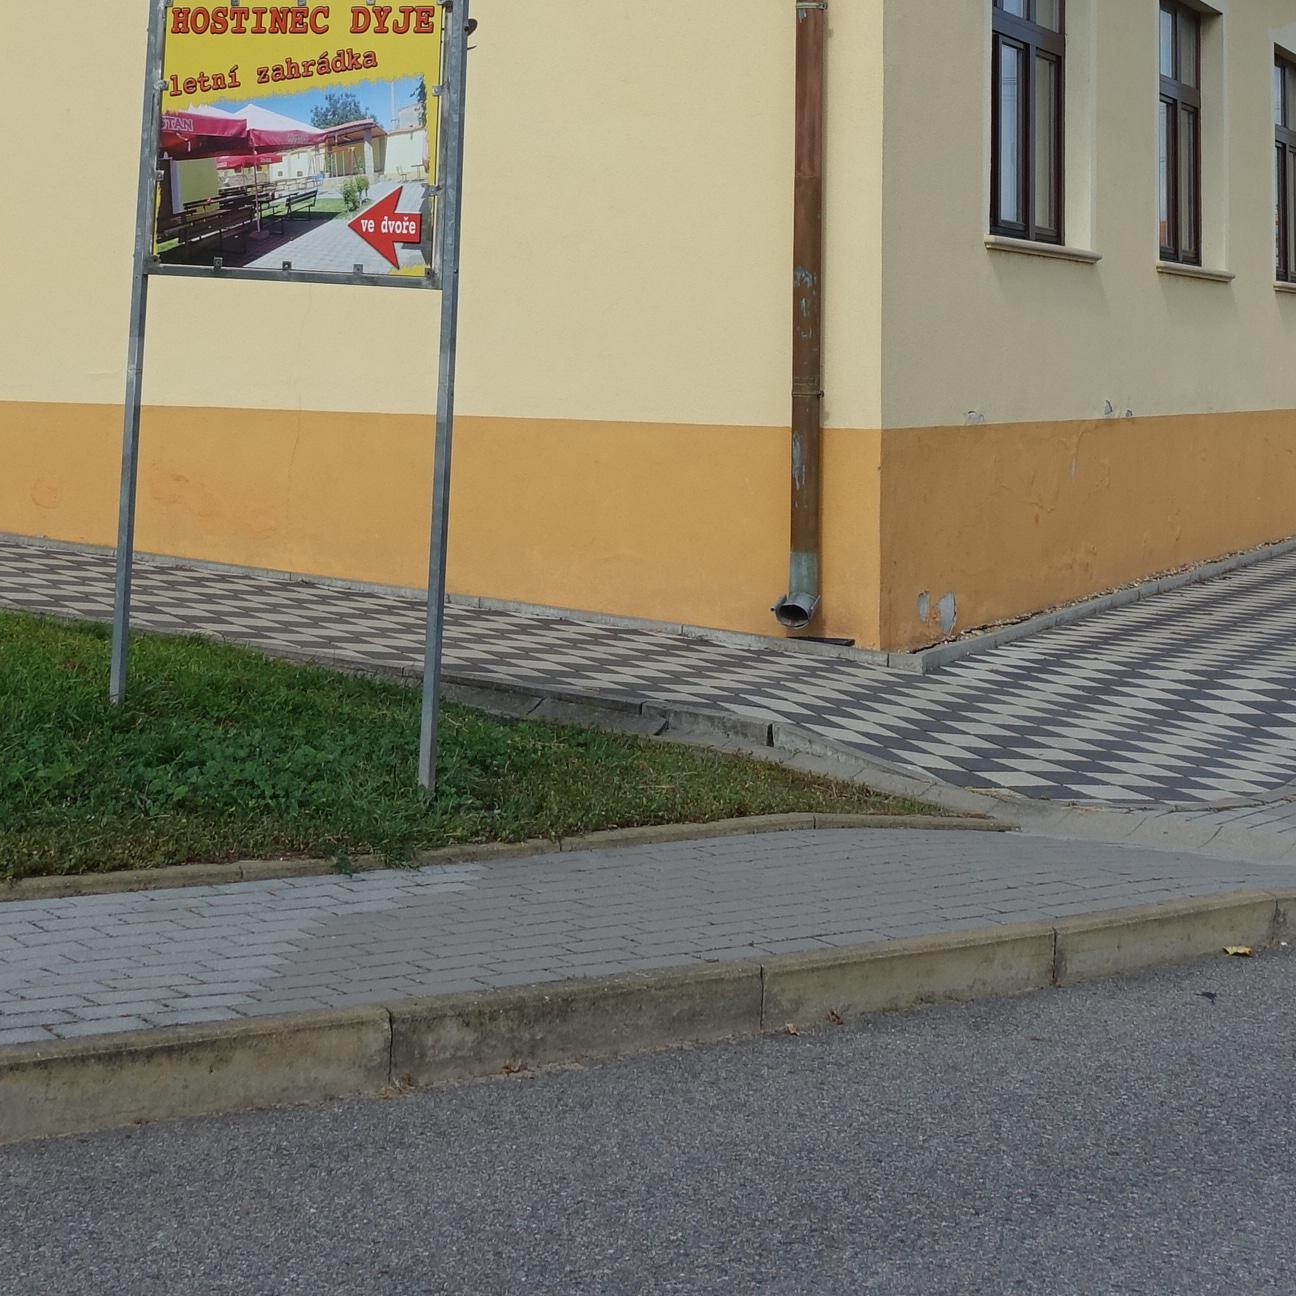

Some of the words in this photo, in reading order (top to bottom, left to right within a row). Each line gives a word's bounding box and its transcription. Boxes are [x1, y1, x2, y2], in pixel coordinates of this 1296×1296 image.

[171, 6, 330, 34] HOSTINEC
[350, 6, 435, 34] DYJE
[169, 65, 241, 96] letní
[257, 48, 378, 84] zahrádka
[361, 219, 375, 233] ve
[381, 216, 416, 234] dvoře
